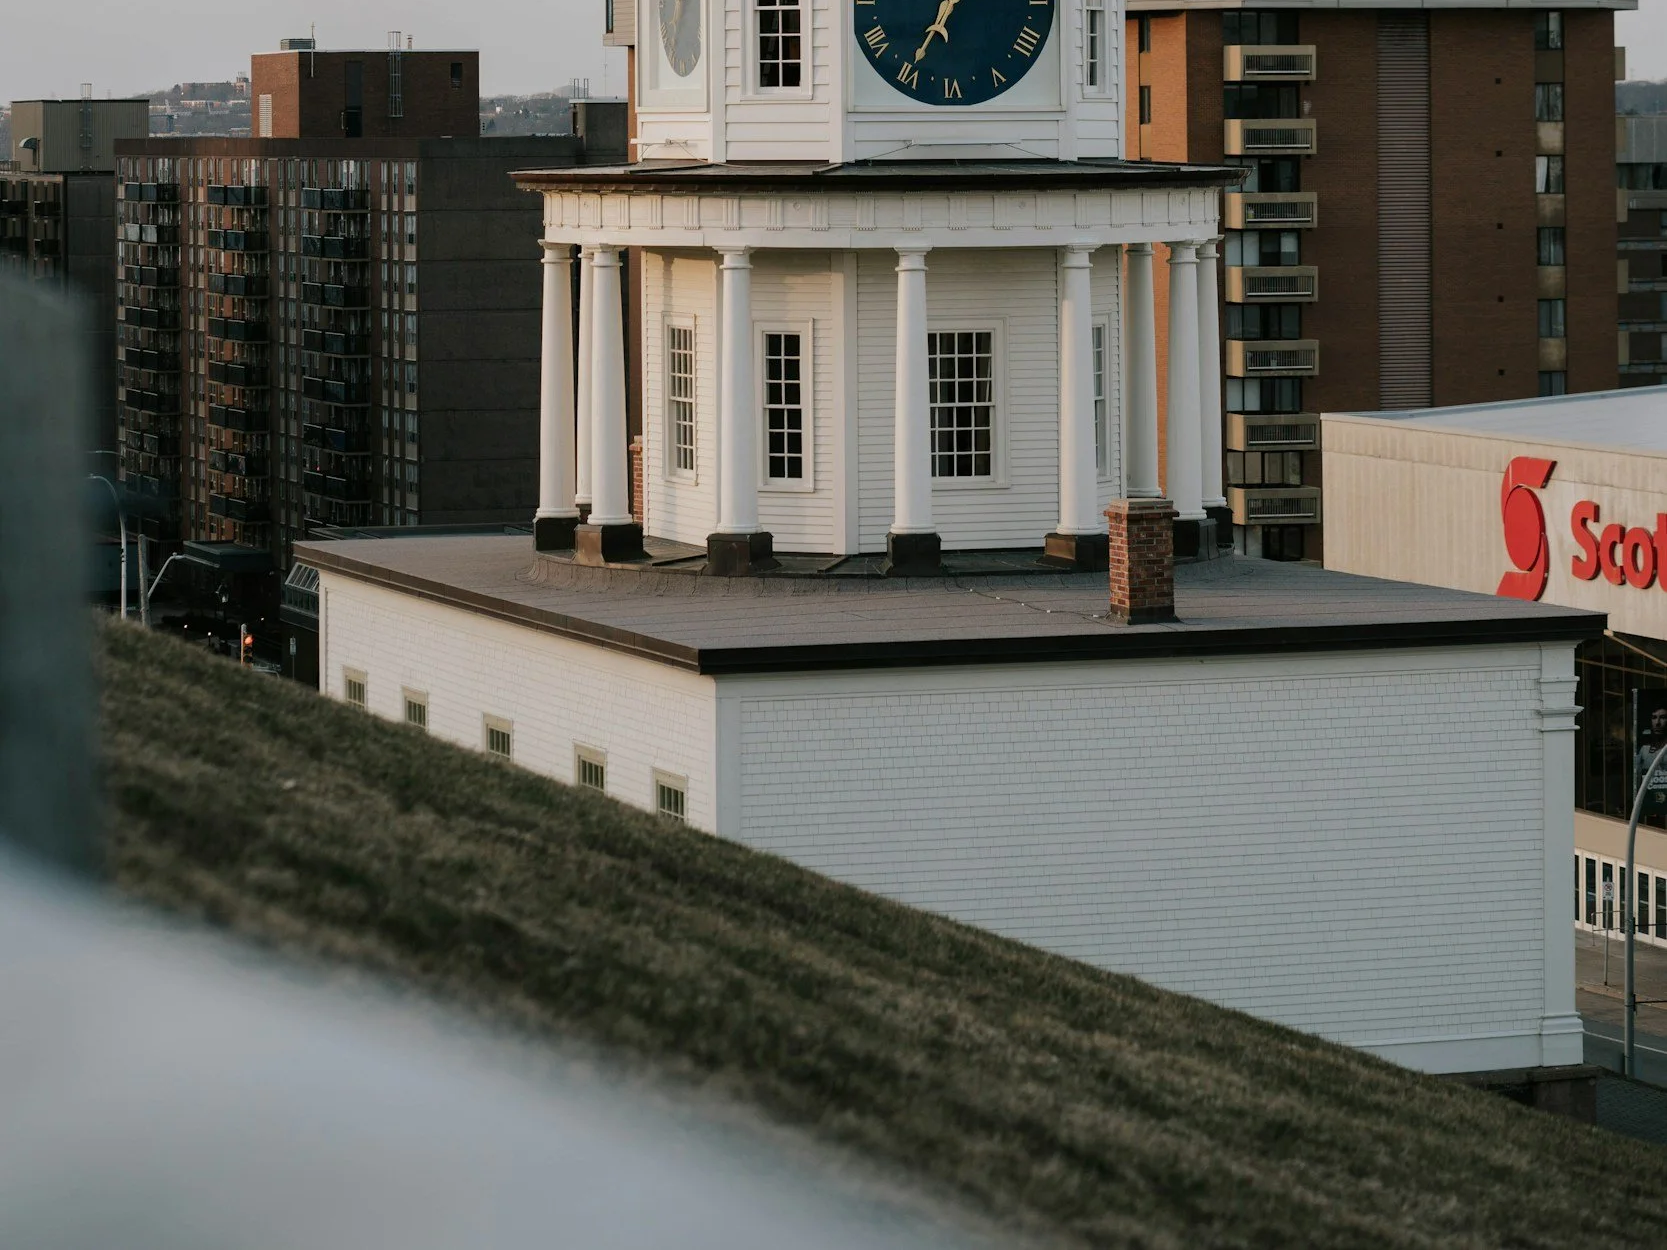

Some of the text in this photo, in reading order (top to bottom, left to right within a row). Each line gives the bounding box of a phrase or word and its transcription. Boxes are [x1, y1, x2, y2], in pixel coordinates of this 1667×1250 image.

[863, 25, 890, 59] VIII
[1013, 26, 1041, 57] IIII
[897, 61, 919, 90] VII
[944, 78, 962, 99] VI
[992, 67, 1007, 88] V
